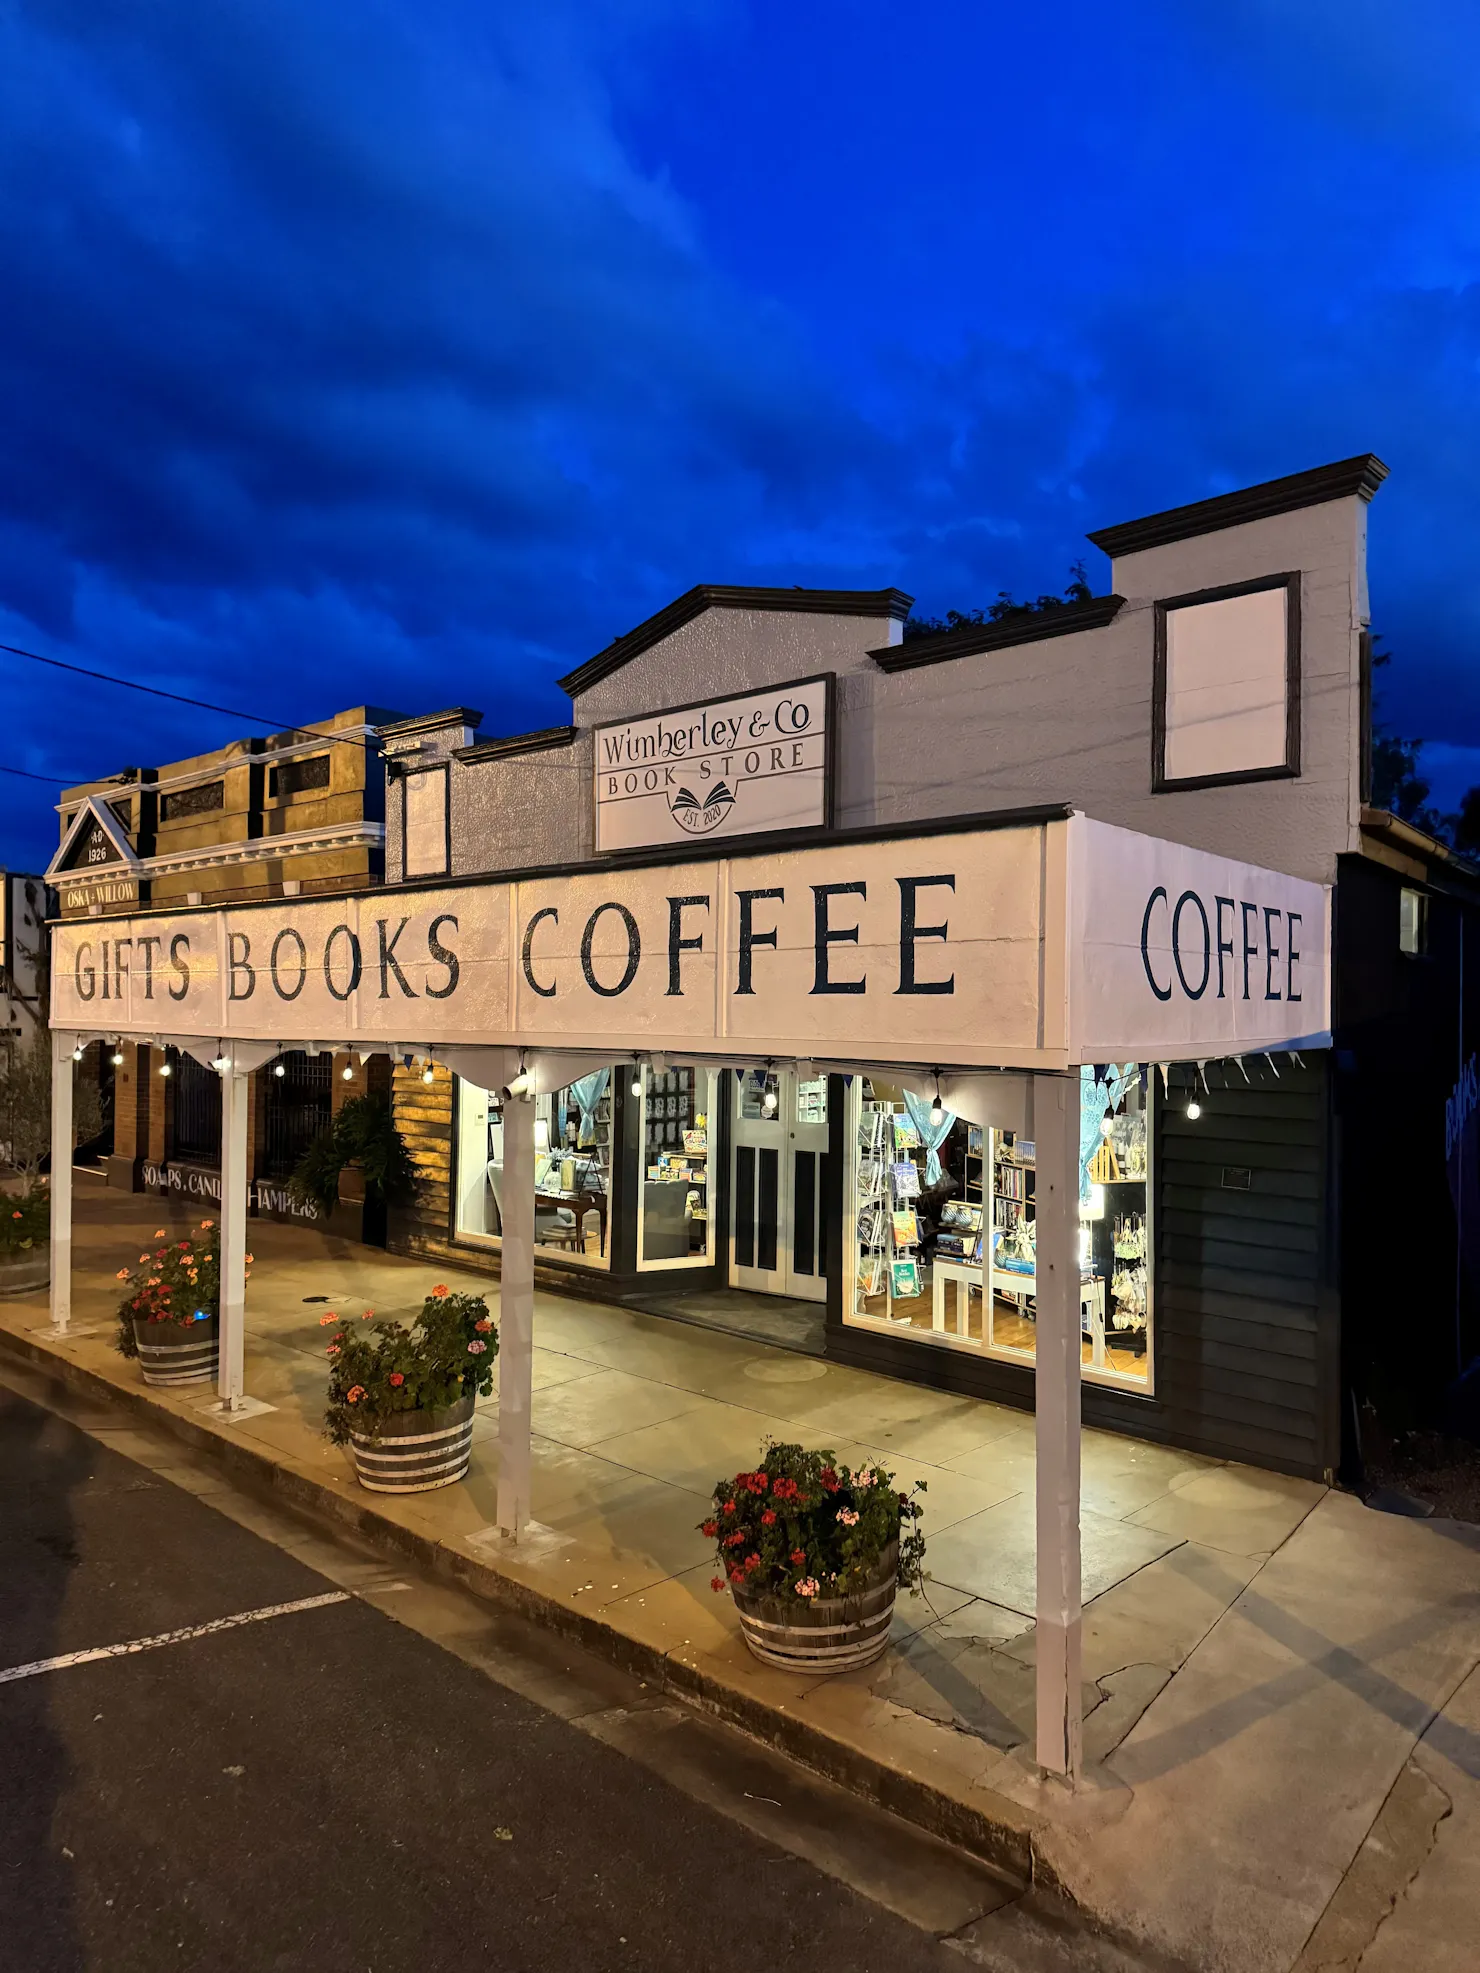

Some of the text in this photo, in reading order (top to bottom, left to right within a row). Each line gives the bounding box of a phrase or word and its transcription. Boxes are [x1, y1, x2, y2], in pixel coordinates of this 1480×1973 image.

[603, 698, 812, 764] Wimberley & Co
[608, 742, 804, 795] BOOK STORE
[683, 804, 722, 827] EST. 2020
[88, 847, 107, 862] 1926
[67, 888, 90, 908] OSKA
[96, 882, 136, 903] WILLOW
[75, 874, 956, 1001] GIFTS BOOKS COFFEE
[1140, 886, 1303, 1002] COFFEE
